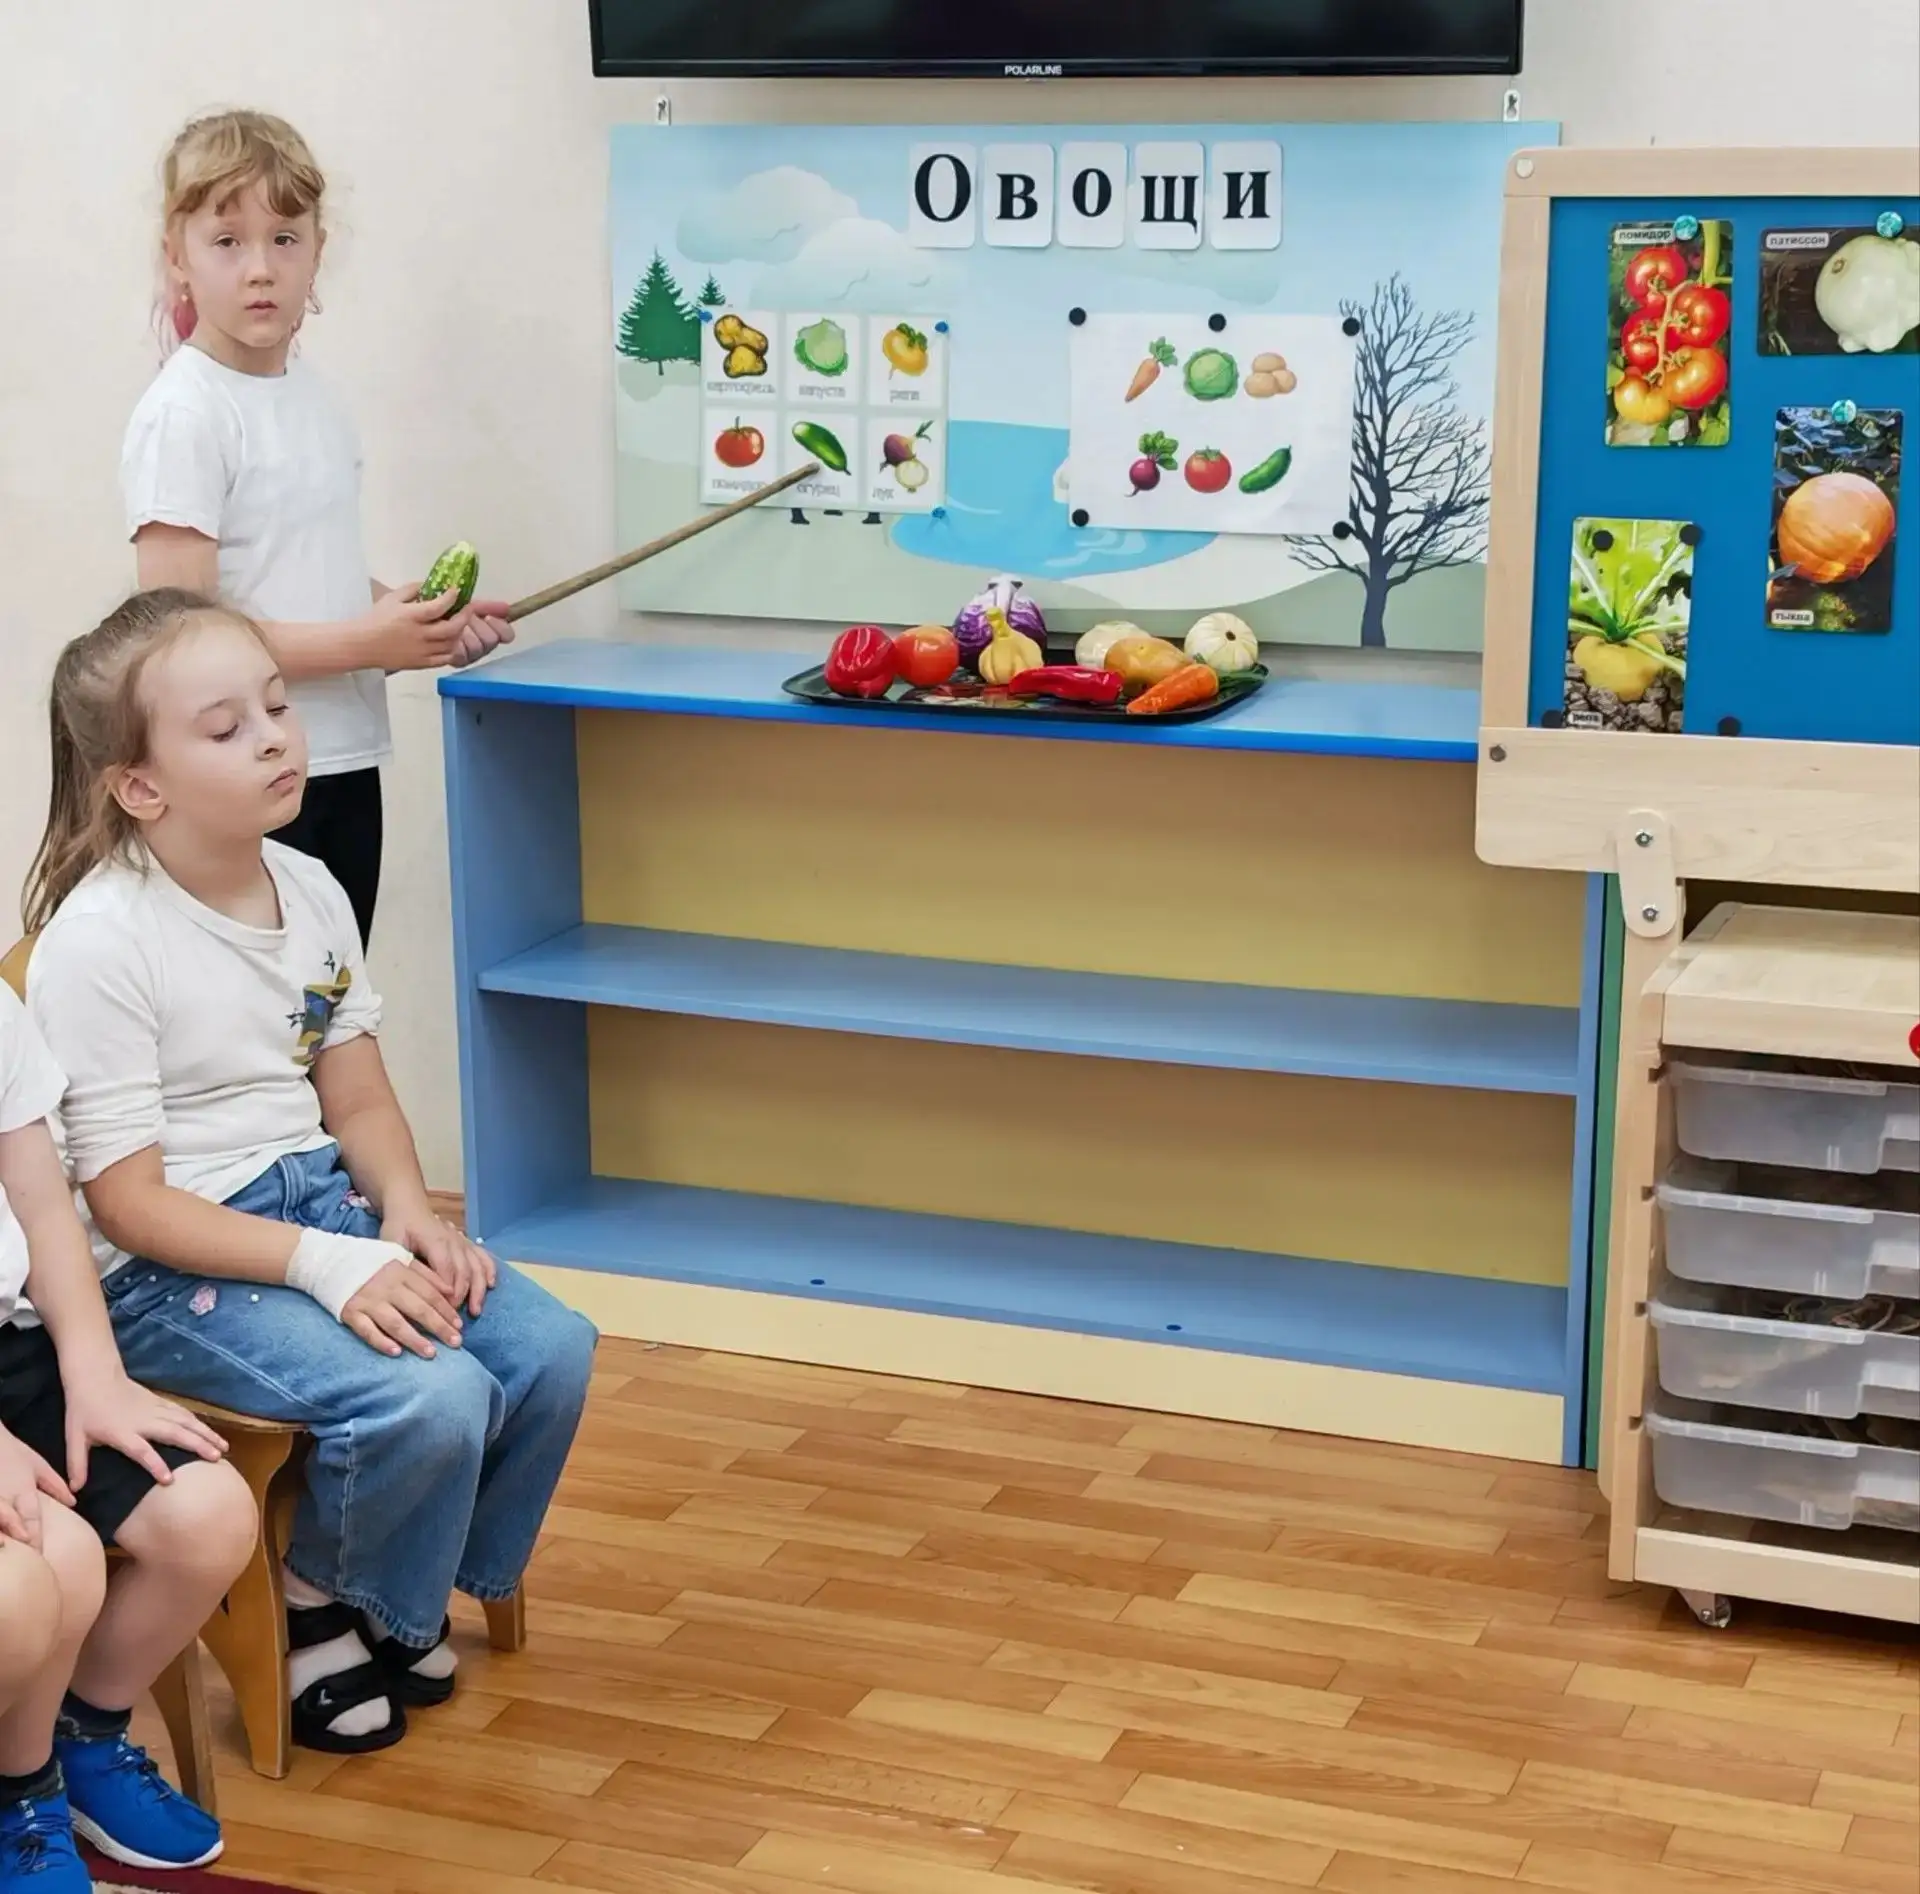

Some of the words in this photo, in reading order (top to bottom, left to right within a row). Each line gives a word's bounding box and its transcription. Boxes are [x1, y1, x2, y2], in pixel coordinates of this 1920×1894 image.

[1004, 64, 1062, 76] POLARLINE
[914, 153, 1271, 234] Овощи
[1619, 230, 1671, 240] помидор
[1770, 236, 1825, 245] патиссон
